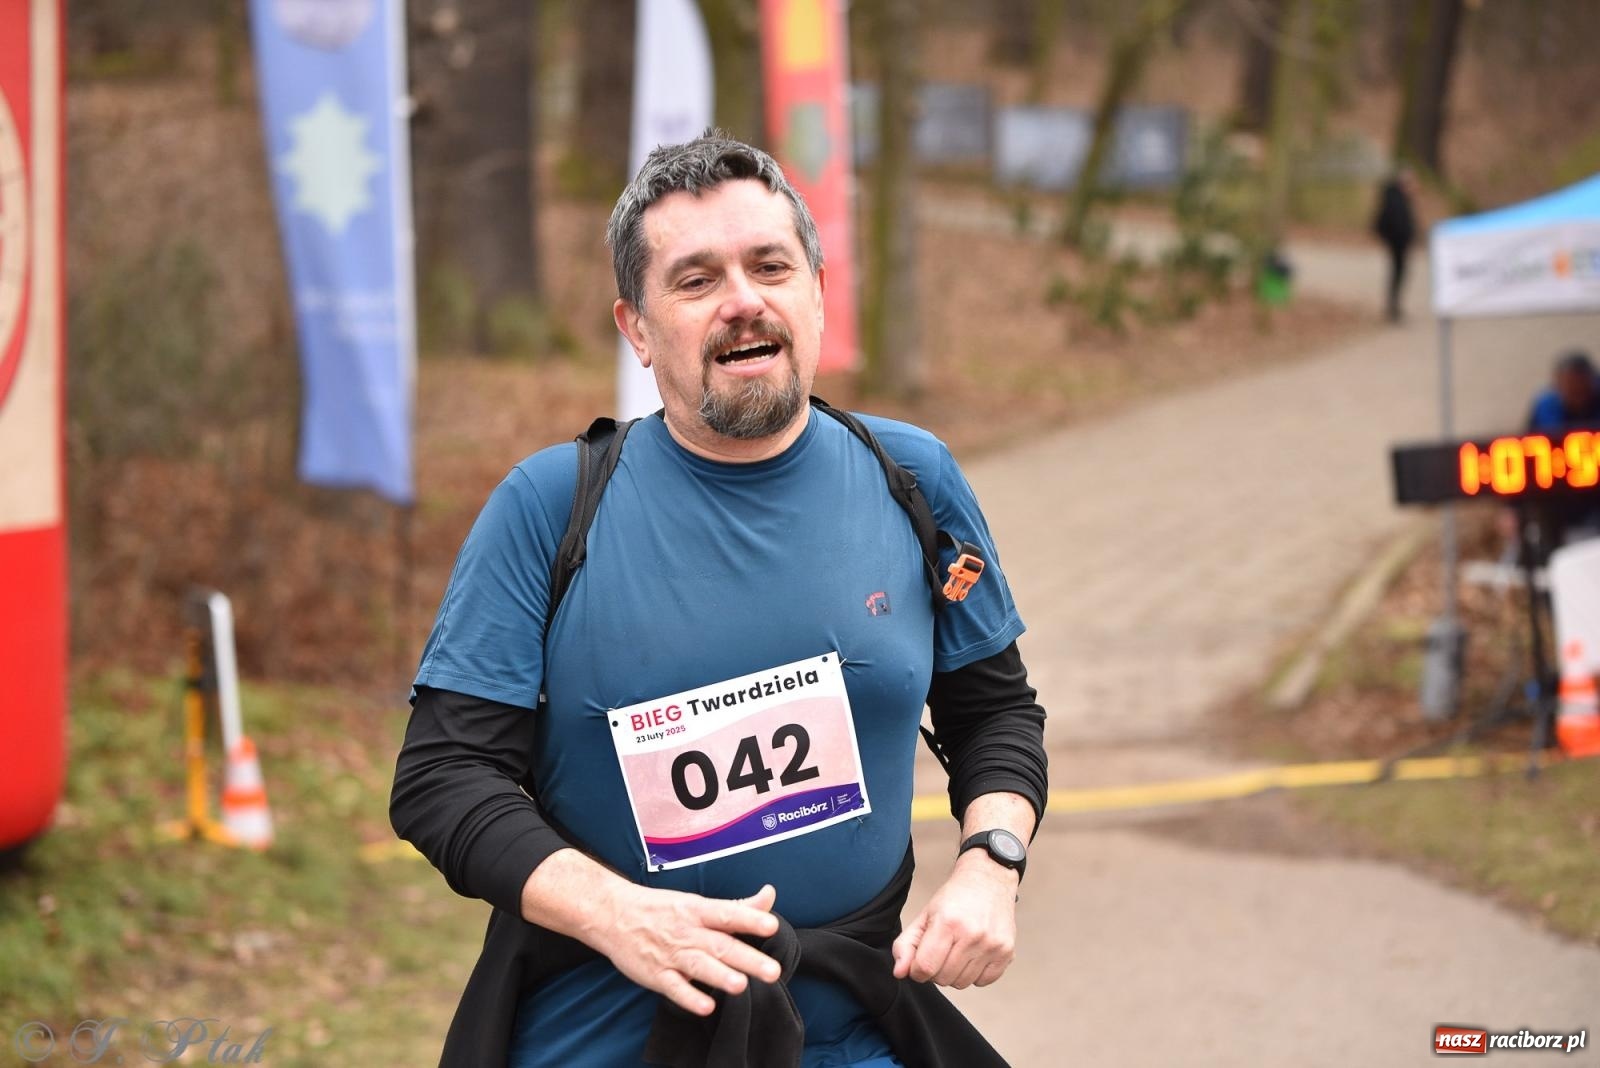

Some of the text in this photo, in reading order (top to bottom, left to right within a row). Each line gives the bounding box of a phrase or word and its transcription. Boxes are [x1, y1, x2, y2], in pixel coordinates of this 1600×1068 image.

[1459, 431, 1600, 496] 1:07:5
[630, 669, 819, 732] BIEG Twardziela
[636, 724, 686, 744] 23 luty 2025
[671, 723, 820, 811] 042
[778, 801, 828, 823] Racibórz
